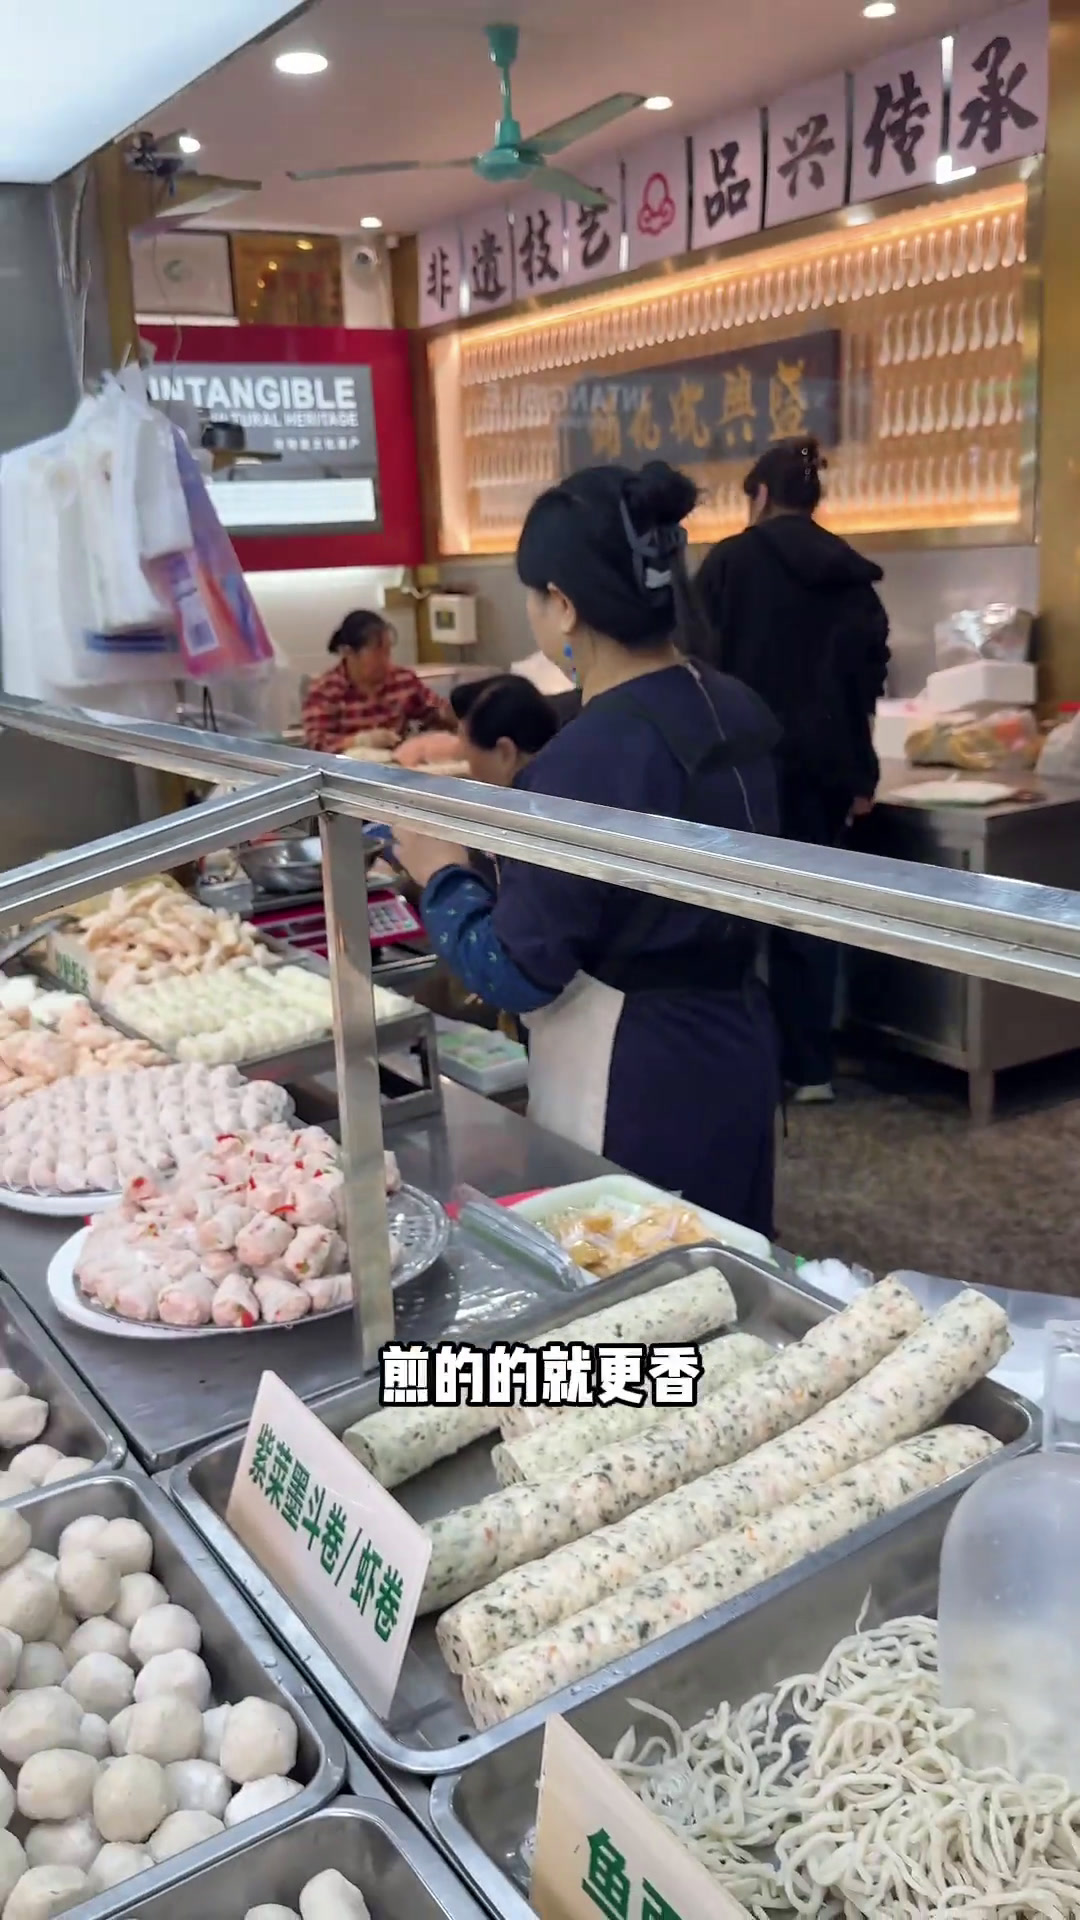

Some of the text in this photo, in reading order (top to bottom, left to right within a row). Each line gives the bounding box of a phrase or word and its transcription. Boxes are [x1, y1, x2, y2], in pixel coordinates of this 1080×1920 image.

[703, 36, 1039, 228] 品兴传承
[149, 376, 358, 410] INTANGIBLE
[284, 411, 359, 428] HERITAGE
[247, 1422, 403, 1643] 紫菜墨斗卷/虾卷
